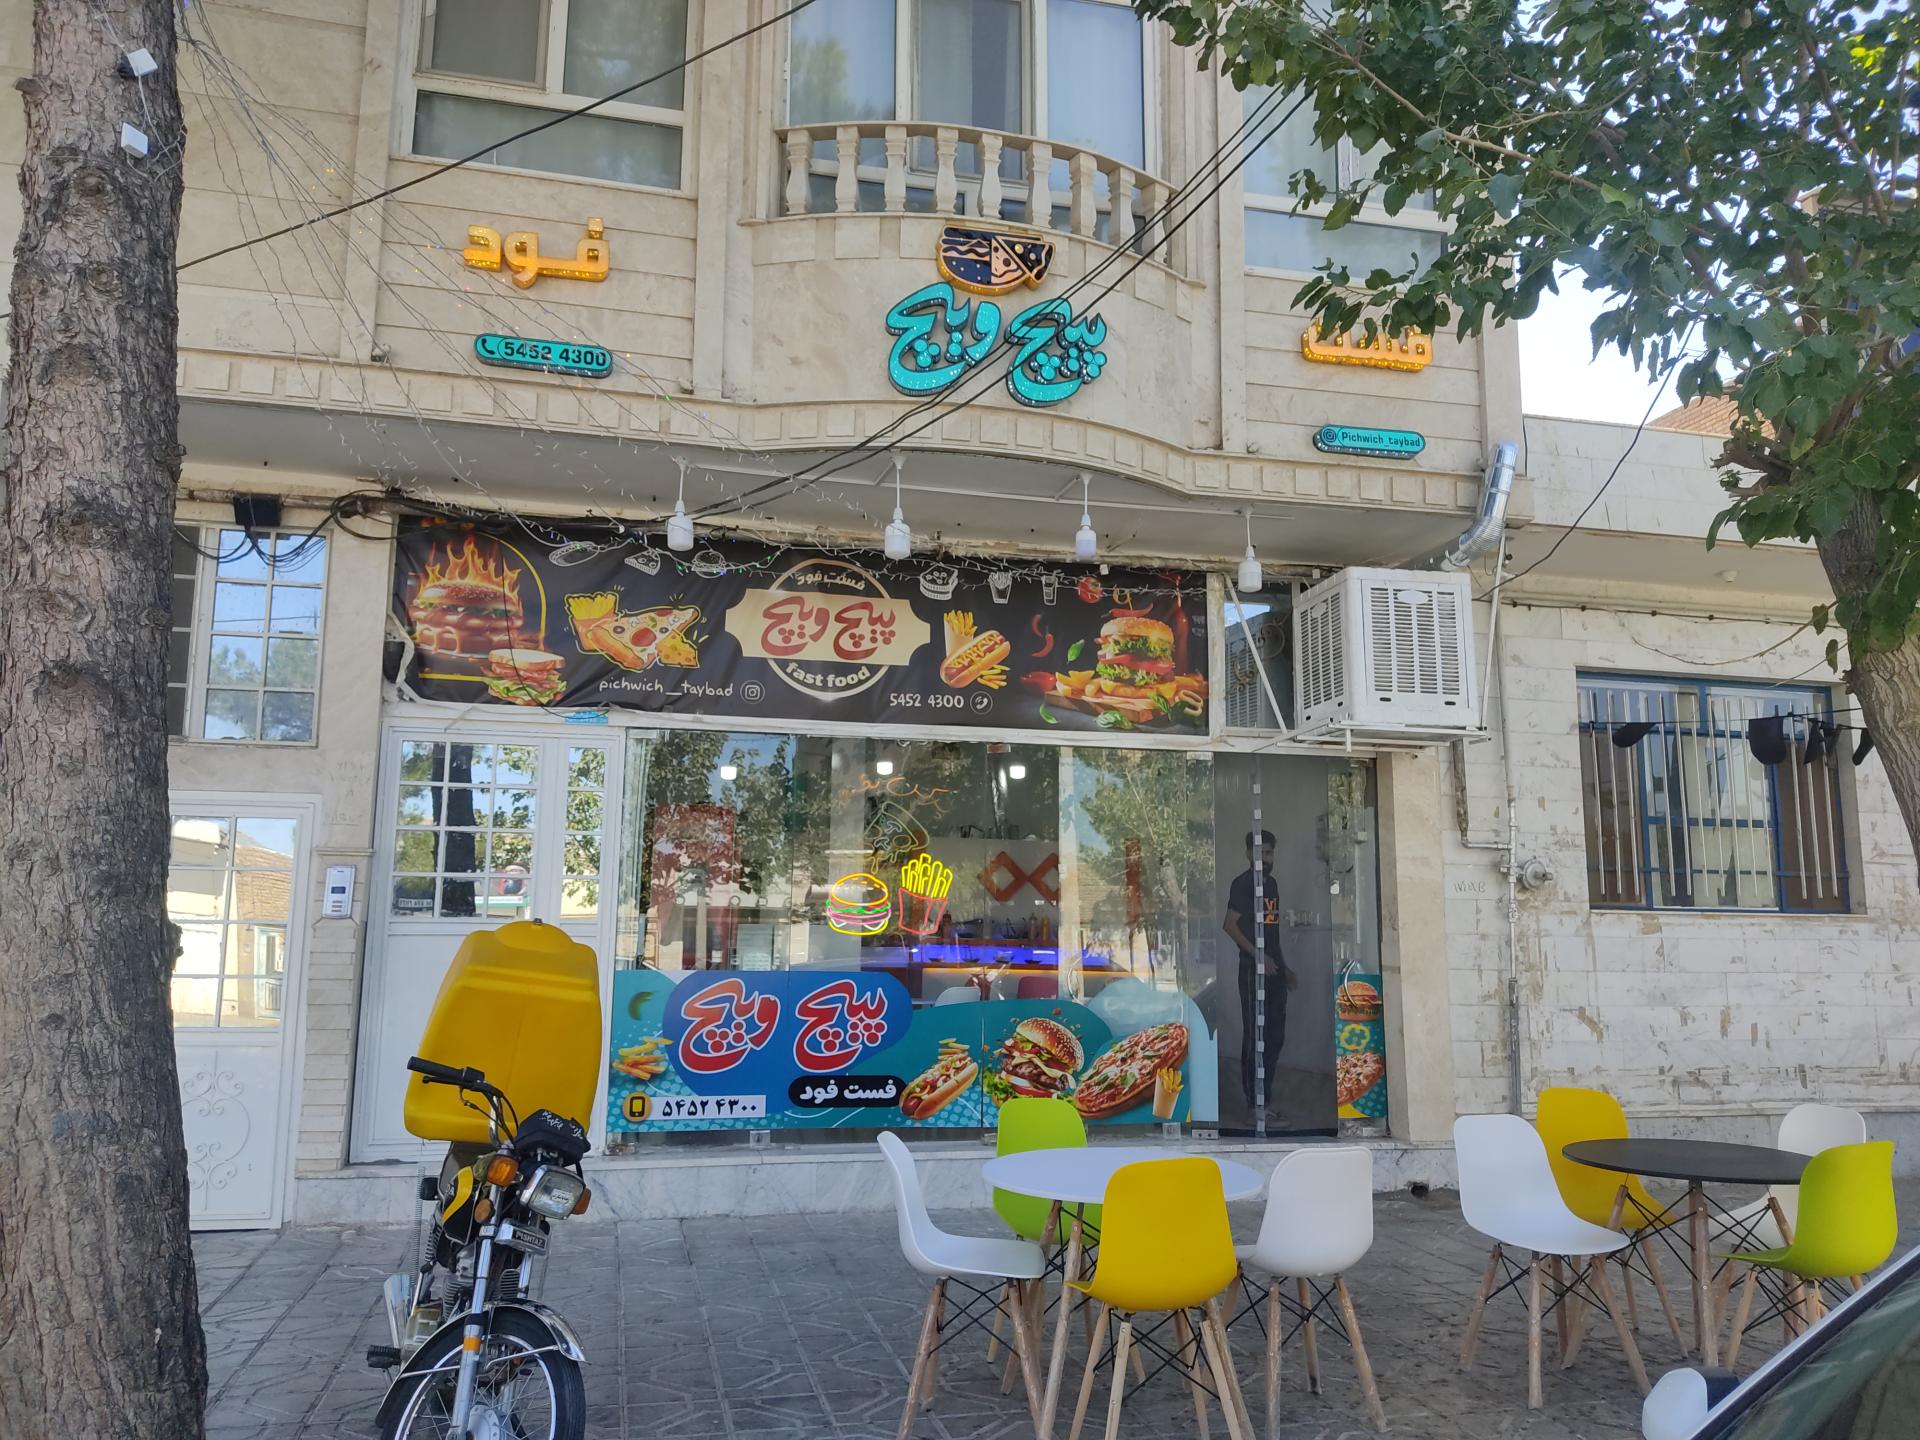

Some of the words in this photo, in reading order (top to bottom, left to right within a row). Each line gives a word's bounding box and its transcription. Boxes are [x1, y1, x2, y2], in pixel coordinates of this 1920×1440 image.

[463, 216, 611, 290] فود
[504, 341, 552, 361] 5452
[559, 348, 607, 368] 4300
[1341, 431, 1421, 448] Pichwich_taybad
[797, 570, 822, 586] فود
[824, 571, 866, 591] فست
[785, 662, 824, 687] fast
[826, 665, 871, 688] food
[889, 692, 922, 708] 5452
[927, 694, 965, 709] 4300
[799, 1079, 839, 1105] فود
[843, 1079, 897, 1101] فست
[662, 1098, 709, 1118] ۵۴۵۲
[715, 1097, 757, 1116] ۴۳۰۰
